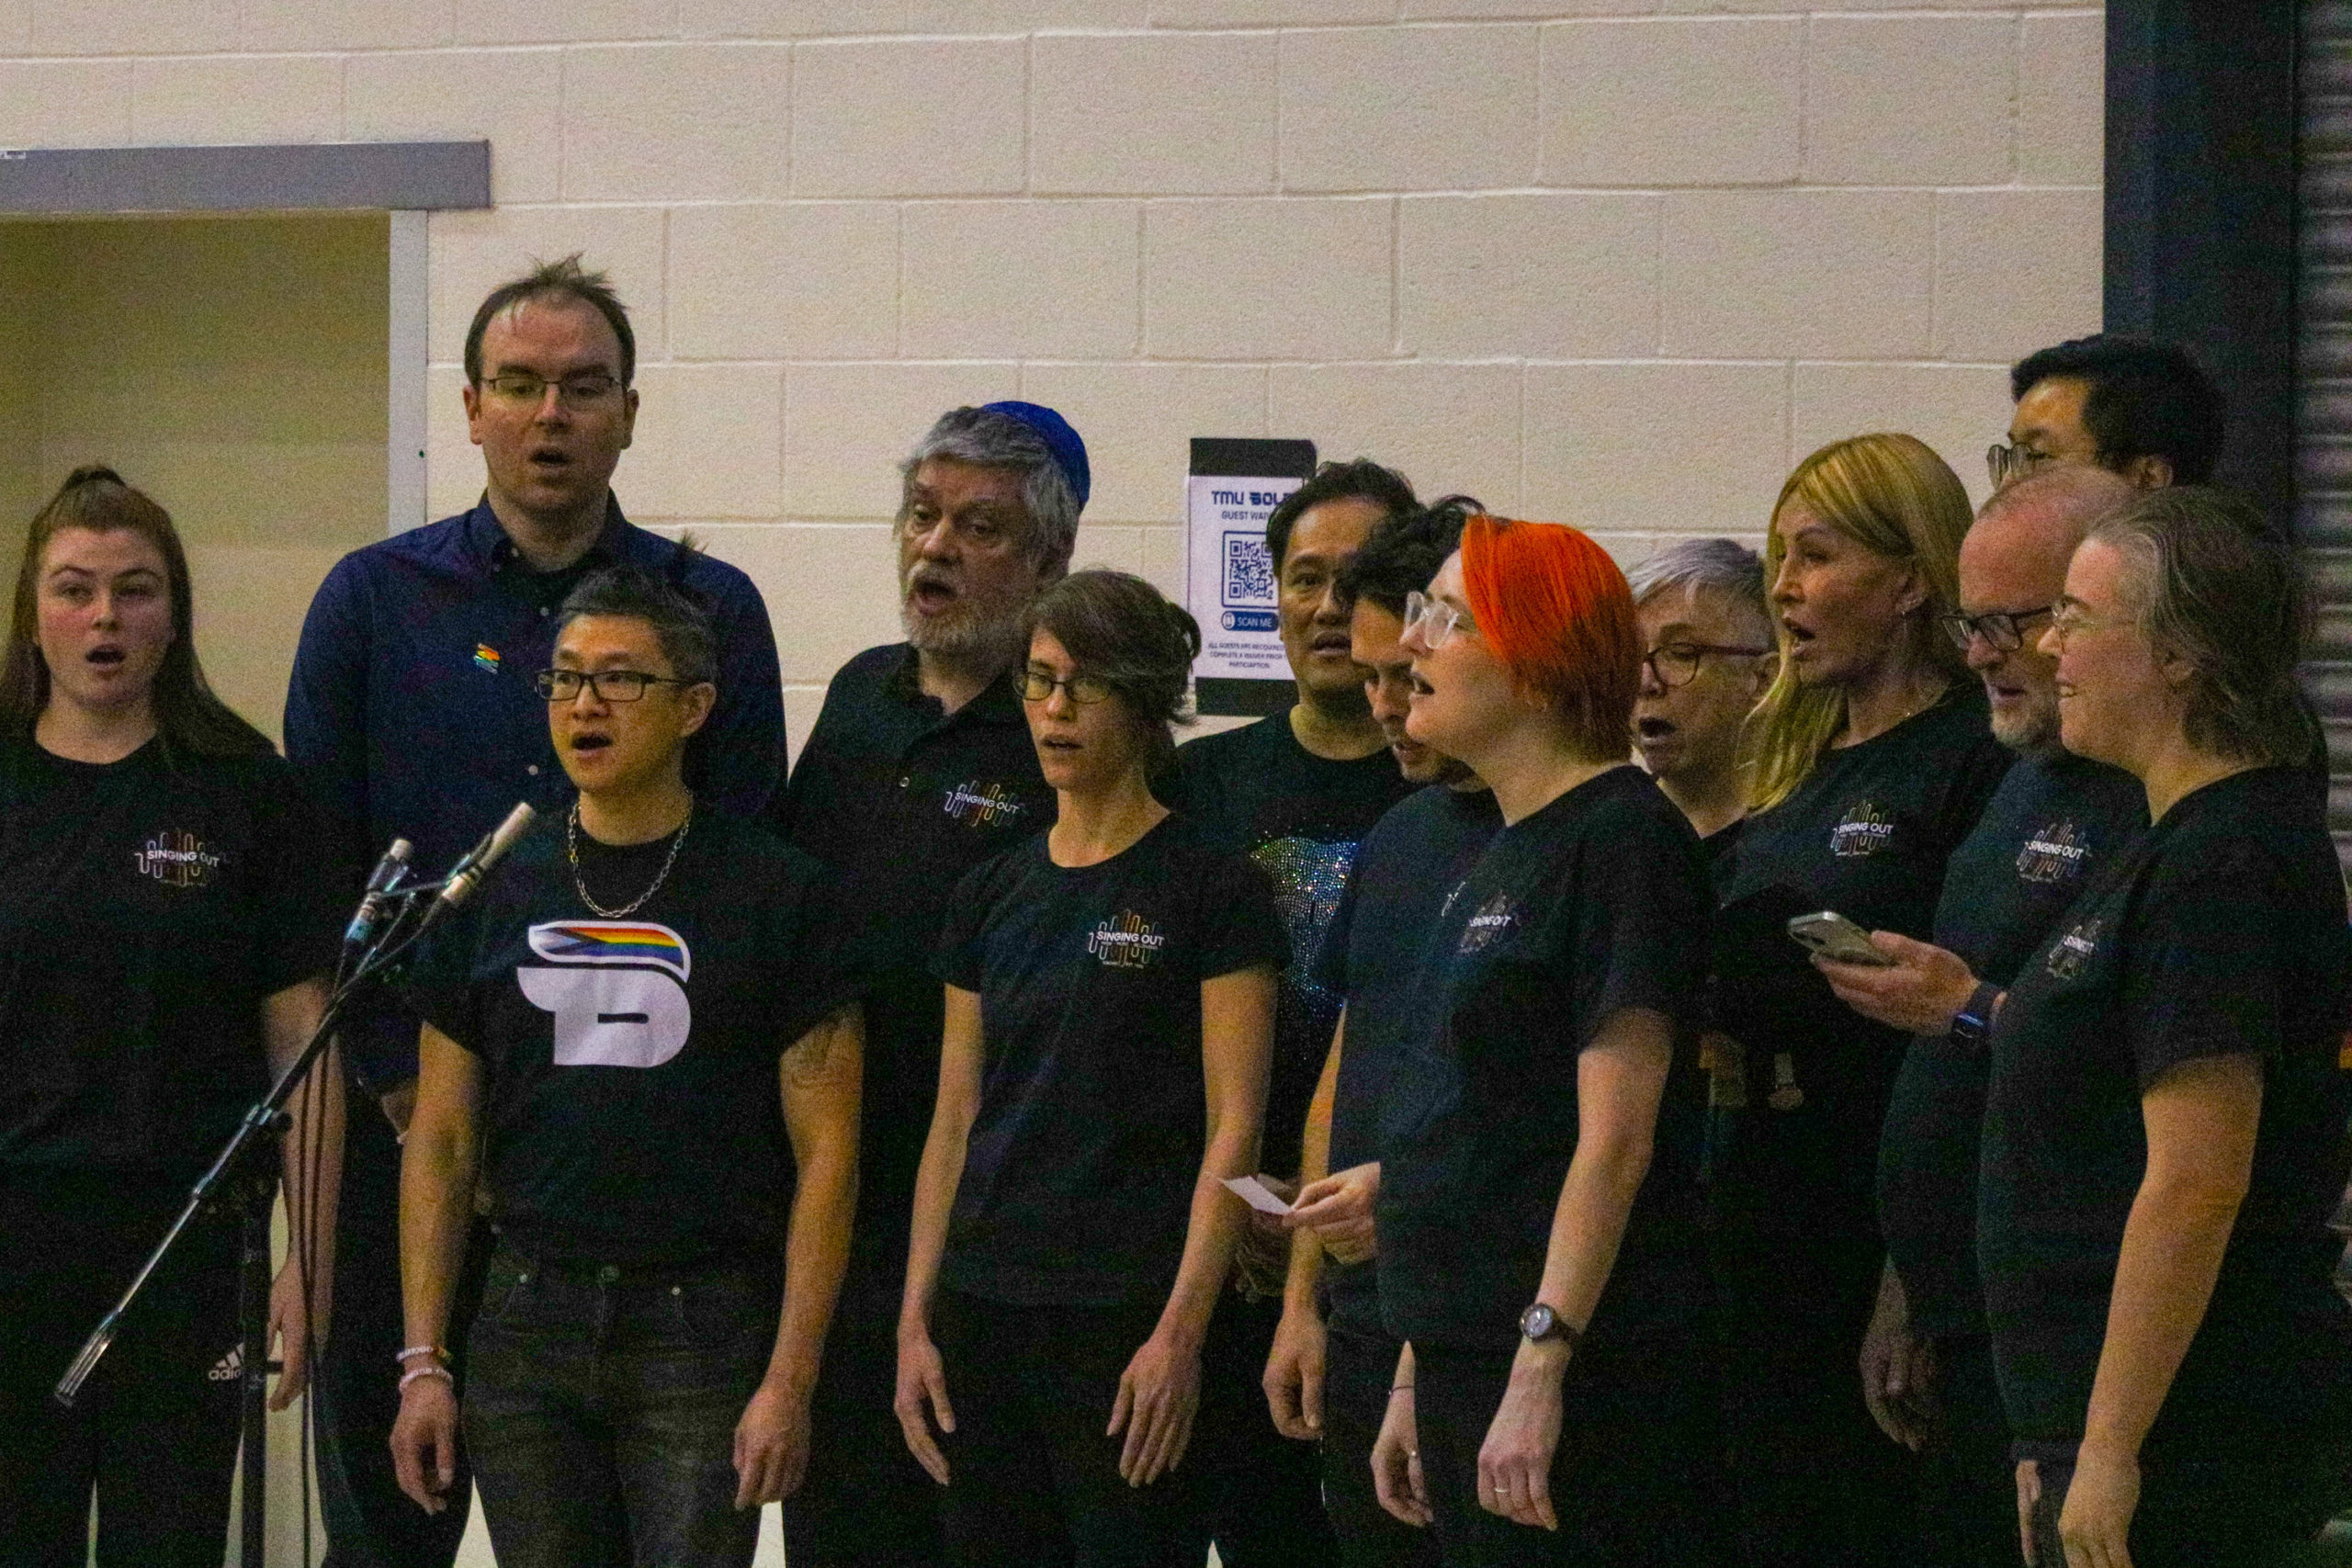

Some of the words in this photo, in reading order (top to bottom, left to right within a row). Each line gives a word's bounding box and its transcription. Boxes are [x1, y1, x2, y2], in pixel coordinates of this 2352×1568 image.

[1212, 491, 1244, 505] TMU
[1221, 511, 1249, 520] GUEST
[1237, 616, 1259, 627] SCAN
[1261, 617, 1272, 627] ME
[956, 792, 996, 808] SINGING
[996, 801, 1020, 815] OUT
[1871, 822, 1894, 834] OUT
[147, 850, 198, 863] SINGING
[200, 852, 220, 868] OUT
[2062, 845, 2084, 860] OUT
[1097, 931, 1140, 942] SINGING
[1141, 933, 1165, 946] OUT
